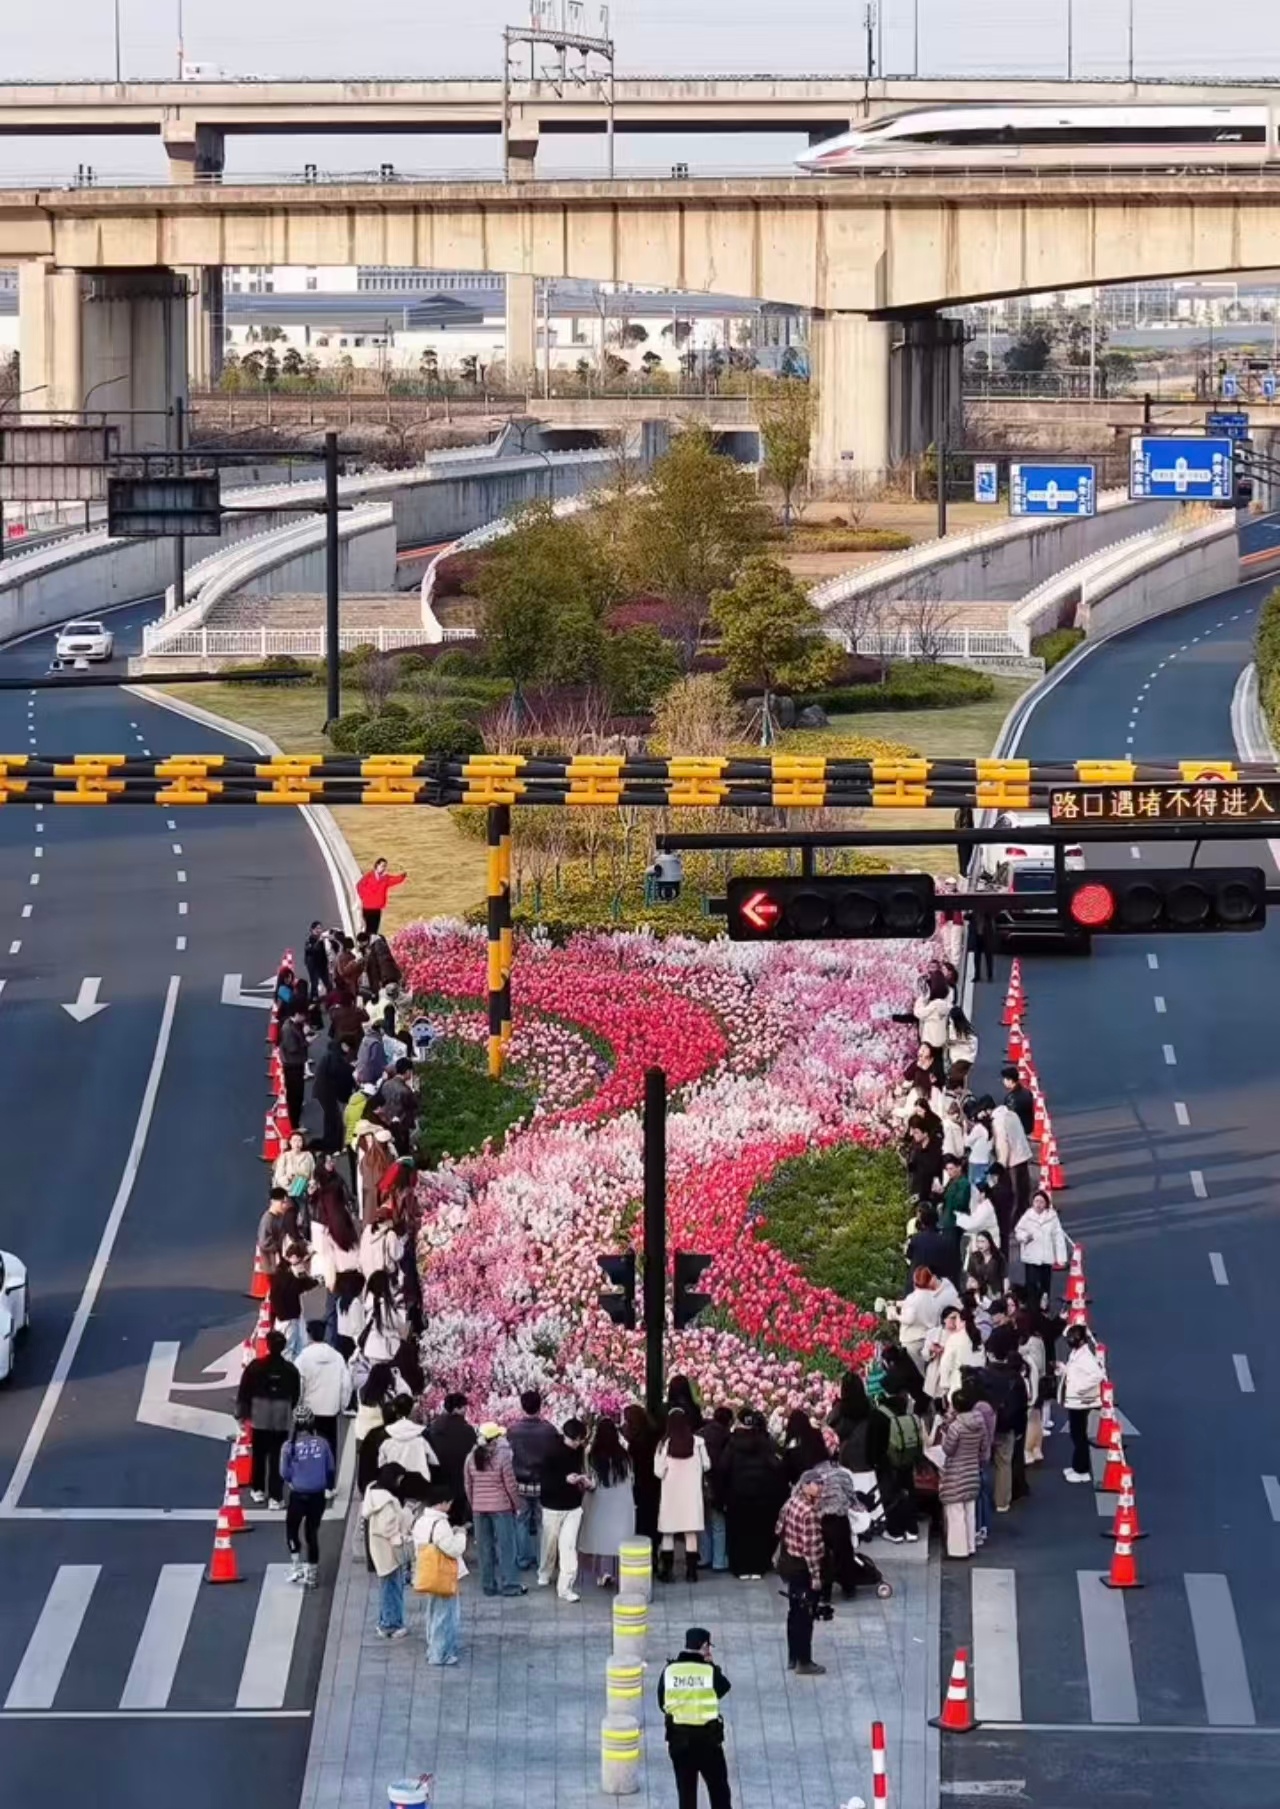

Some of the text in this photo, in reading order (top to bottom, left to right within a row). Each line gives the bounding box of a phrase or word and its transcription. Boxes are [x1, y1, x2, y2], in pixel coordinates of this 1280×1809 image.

[1052, 787, 1275, 818] 路口遇堵不得进入
